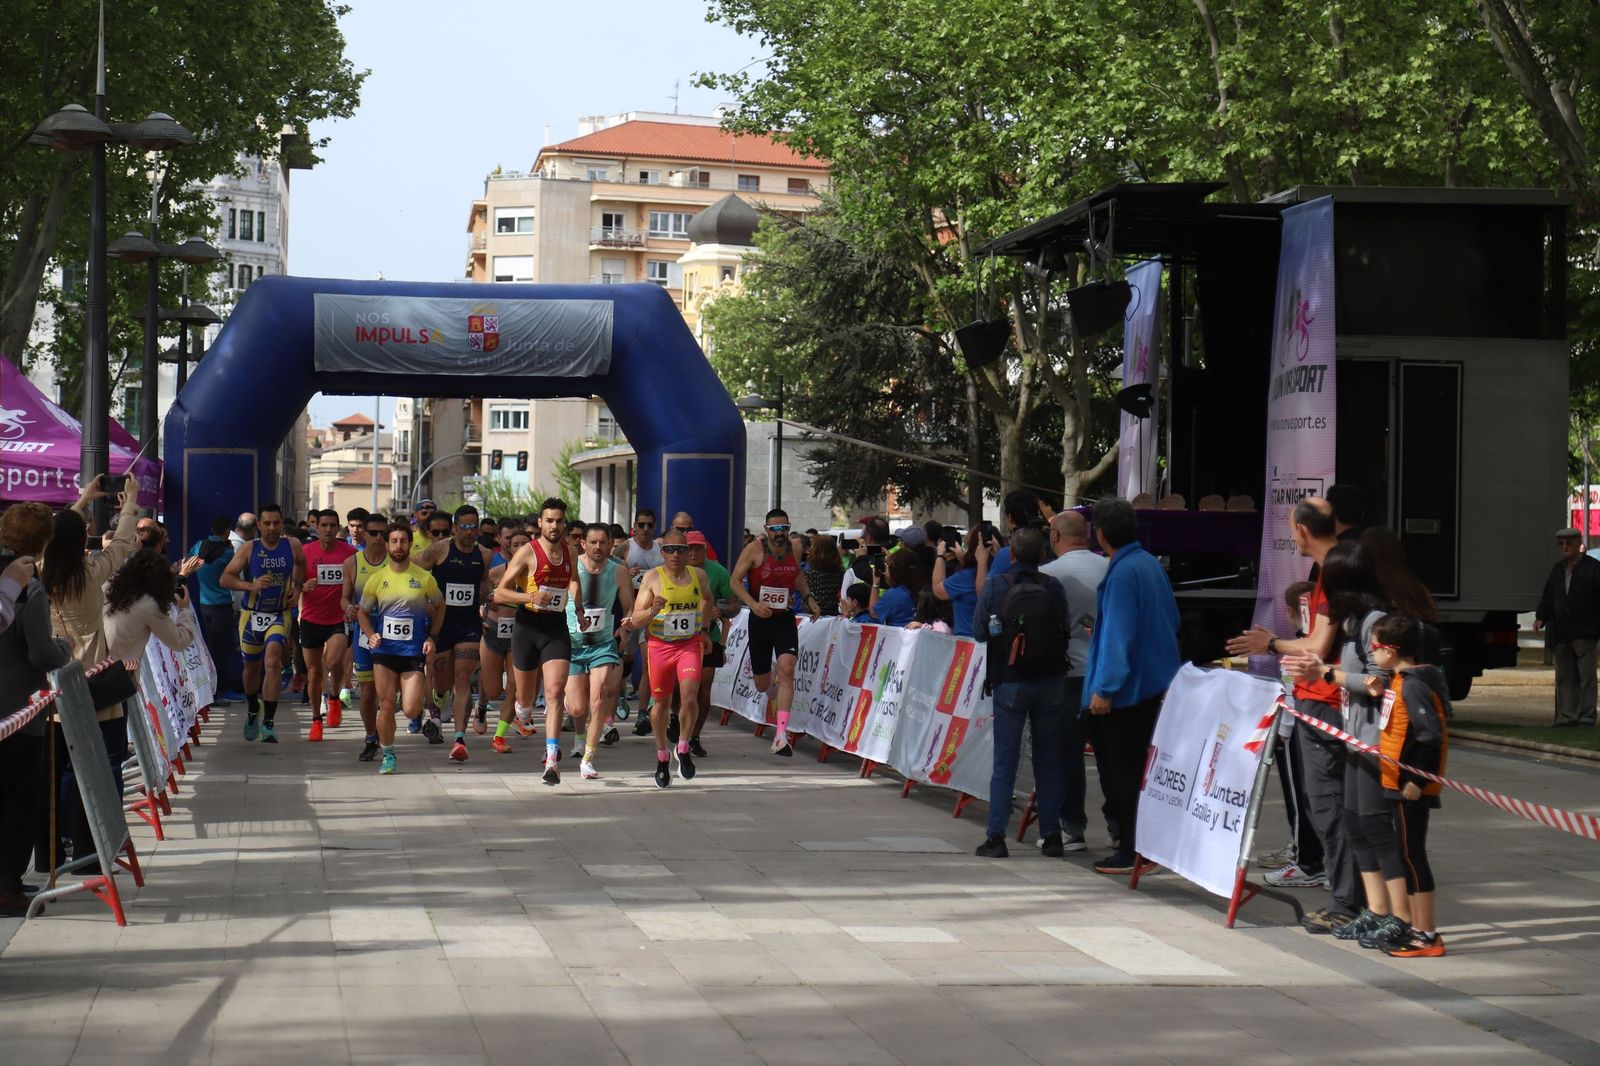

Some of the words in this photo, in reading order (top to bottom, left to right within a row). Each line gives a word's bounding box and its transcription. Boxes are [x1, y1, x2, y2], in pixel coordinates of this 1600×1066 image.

[355, 311, 390, 324] NOS
[260, 557, 286, 569] JESUS
[320, 570, 342, 580] 159
[449, 590, 472, 601] 105
[762, 593, 785, 604] 266
[669, 602, 698, 611] TEAM
[256, 616, 271, 627] 92
[671, 618, 689, 630] 18
[386, 623, 411, 635] 156
